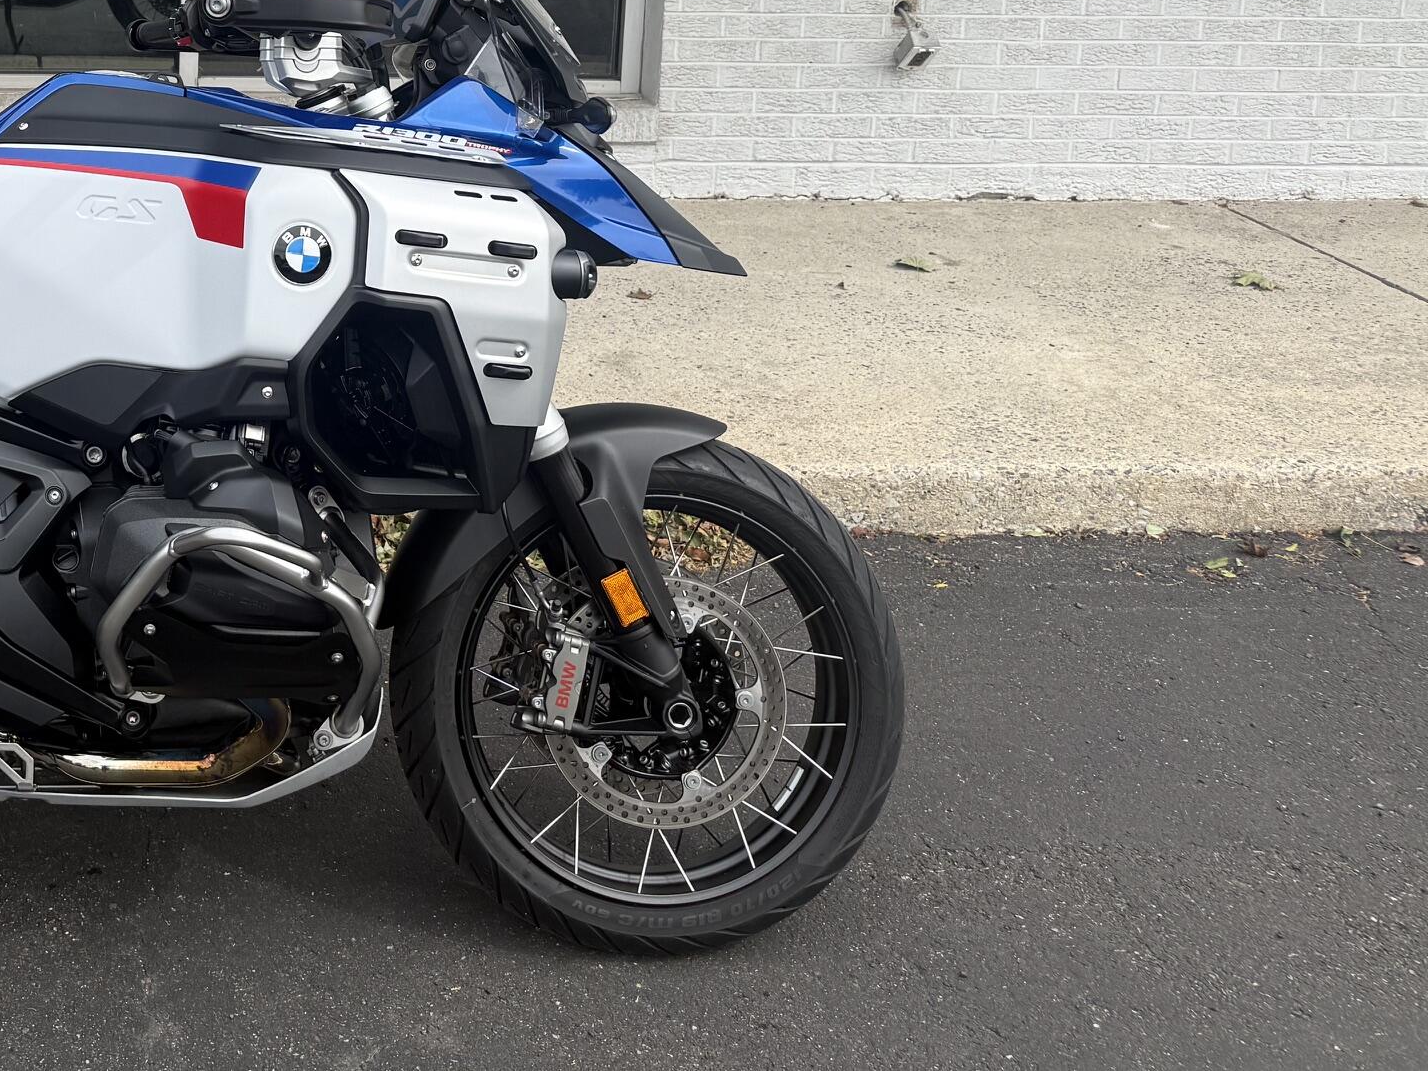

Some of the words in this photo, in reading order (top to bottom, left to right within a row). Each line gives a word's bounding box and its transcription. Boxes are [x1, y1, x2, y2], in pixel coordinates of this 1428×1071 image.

[465, 141, 512, 155] TROPHY
[281, 226, 328, 249] BMW
[554, 660, 577, 709] BMW
